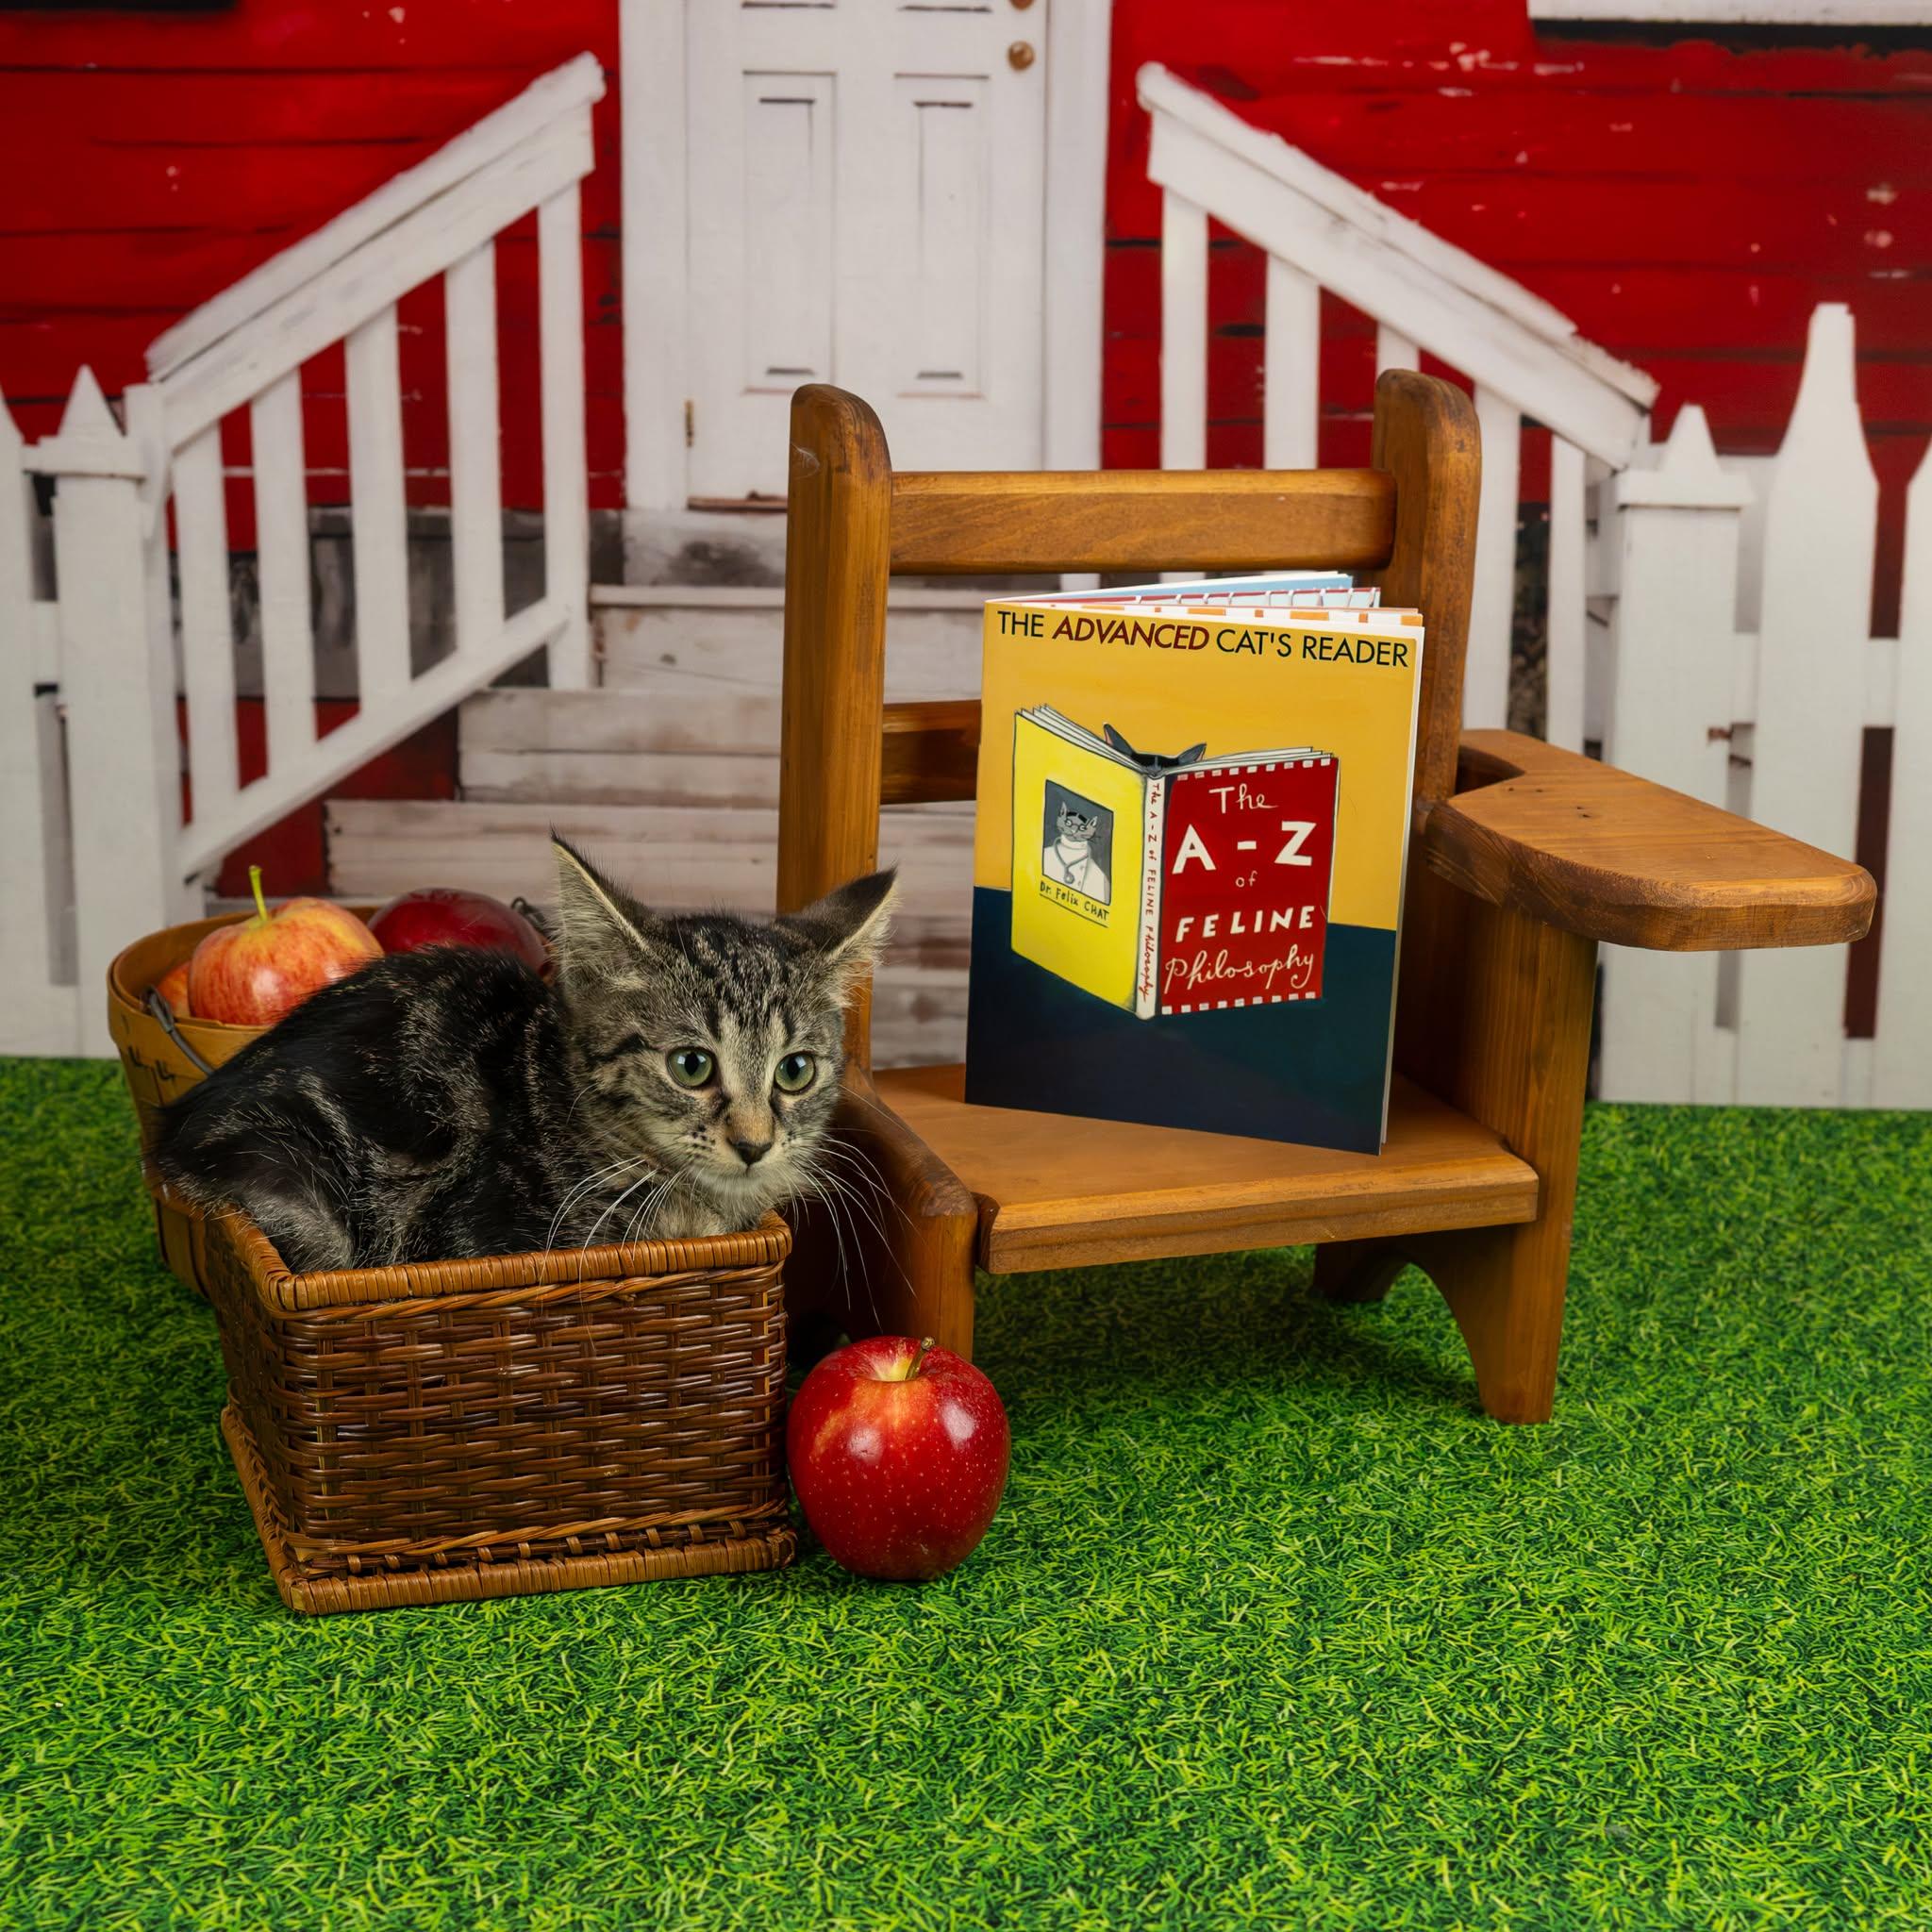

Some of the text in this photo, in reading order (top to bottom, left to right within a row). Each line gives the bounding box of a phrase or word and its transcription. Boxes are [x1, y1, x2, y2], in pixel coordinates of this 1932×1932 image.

[997, 610, 1408, 667] THE ADVANCED CAT'S READER
[1151, 783, 1161, 805] The
[1208, 783, 1280, 814] The
[1148, 850, 1157, 860] of
[1145, 869, 1157, 915] FELINE
[1235, 870, 1257, 888] of
[1040, 880, 1109, 921] Dr. Felix CHAT
[1175, 906, 1315, 942] FELINE
[1164, 943, 1314, 994] Philosophy
